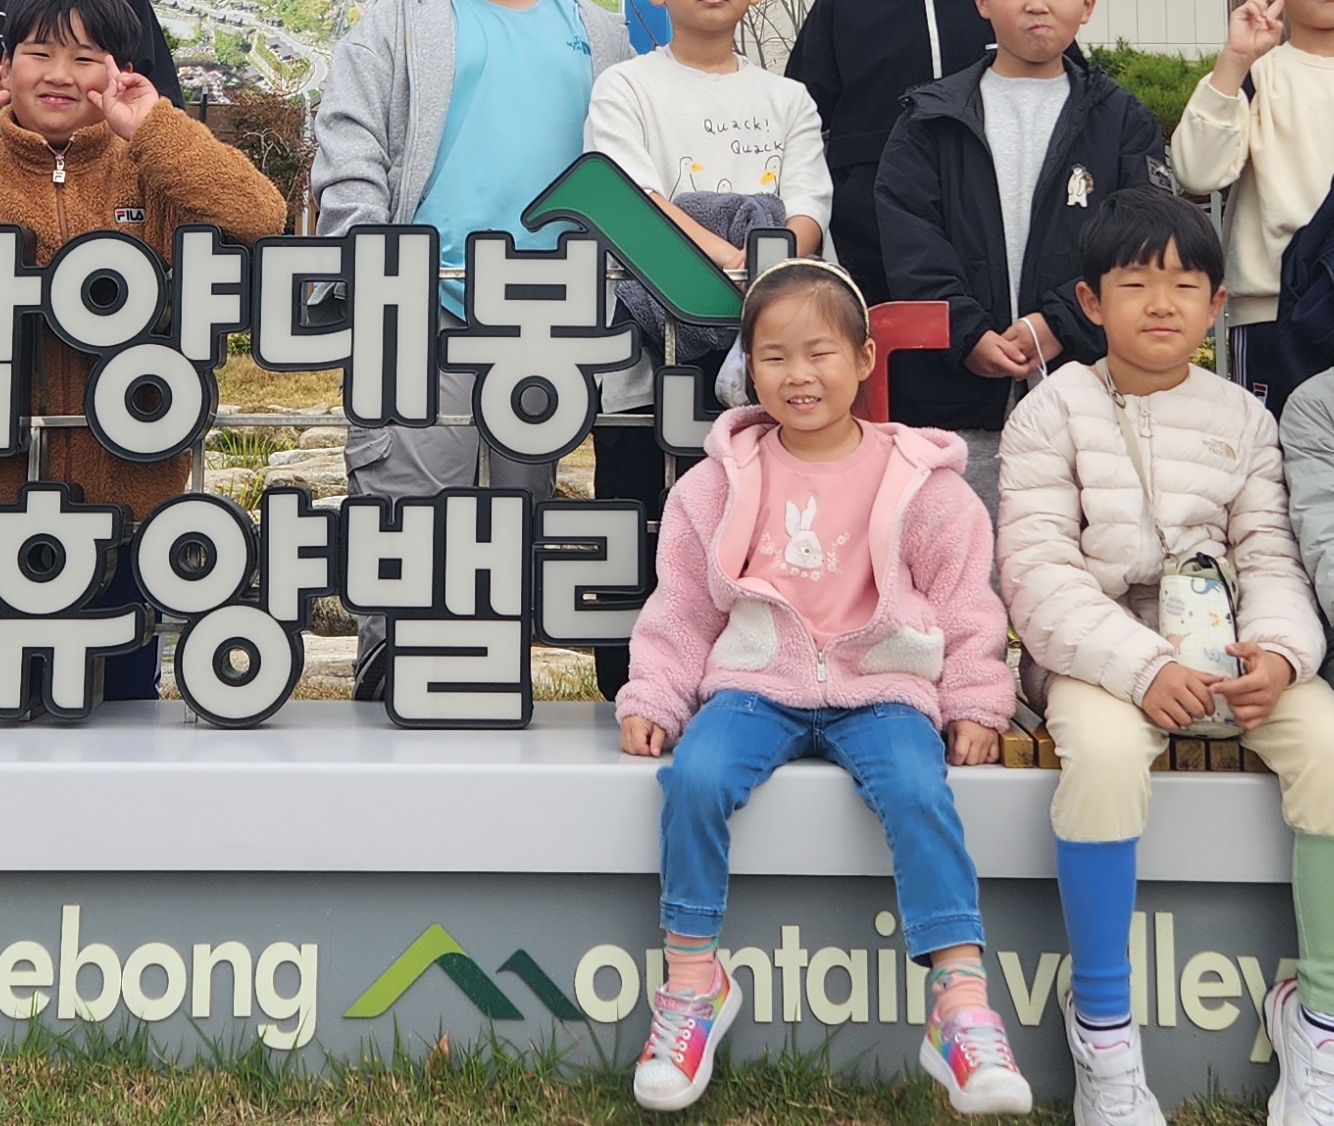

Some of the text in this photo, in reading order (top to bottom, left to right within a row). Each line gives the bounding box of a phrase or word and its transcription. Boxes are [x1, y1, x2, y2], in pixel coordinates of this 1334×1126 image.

[704, 116, 770, 134] Quack!
[730, 140, 785, 155] Quack
[115, 210, 145, 221] FILA
[997, 911, 1298, 1063] vlley
